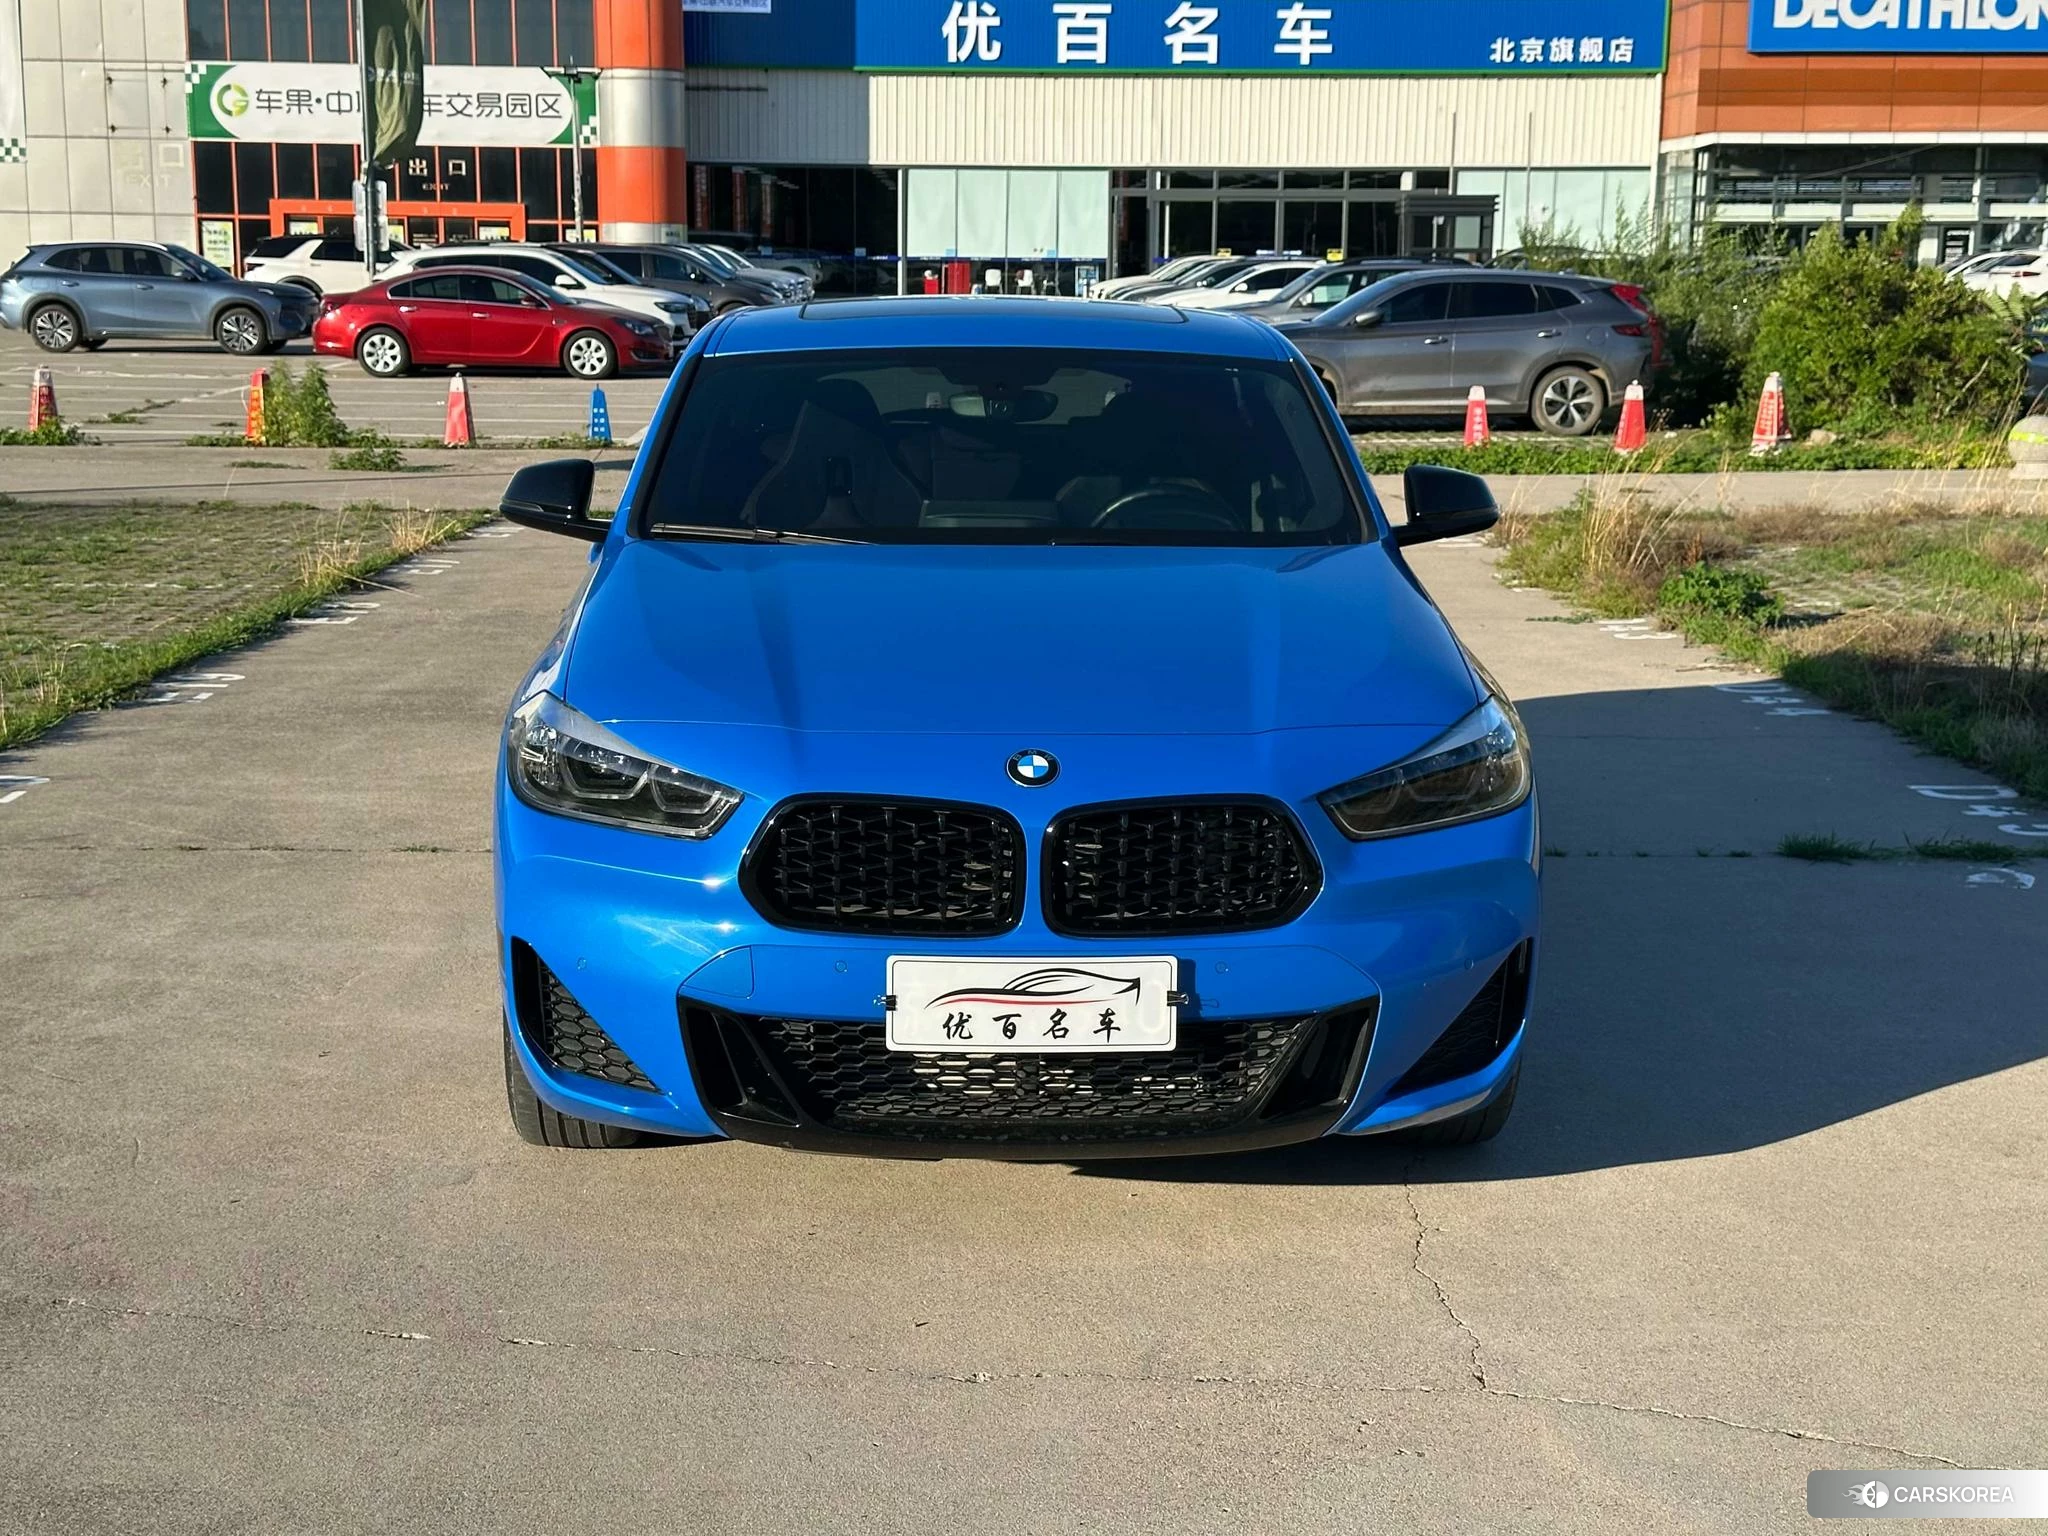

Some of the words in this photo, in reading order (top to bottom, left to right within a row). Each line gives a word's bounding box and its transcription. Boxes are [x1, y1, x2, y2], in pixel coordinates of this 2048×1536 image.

[942, 1, 1333, 65] 优百名车
[1489, 36, 1634, 63] 北京旗舰店
[256, 88, 562, 119] 车果·中车交易园区
[408, 157, 466, 177] 出口
[942, 1007, 1121, 1043] 优百名车
